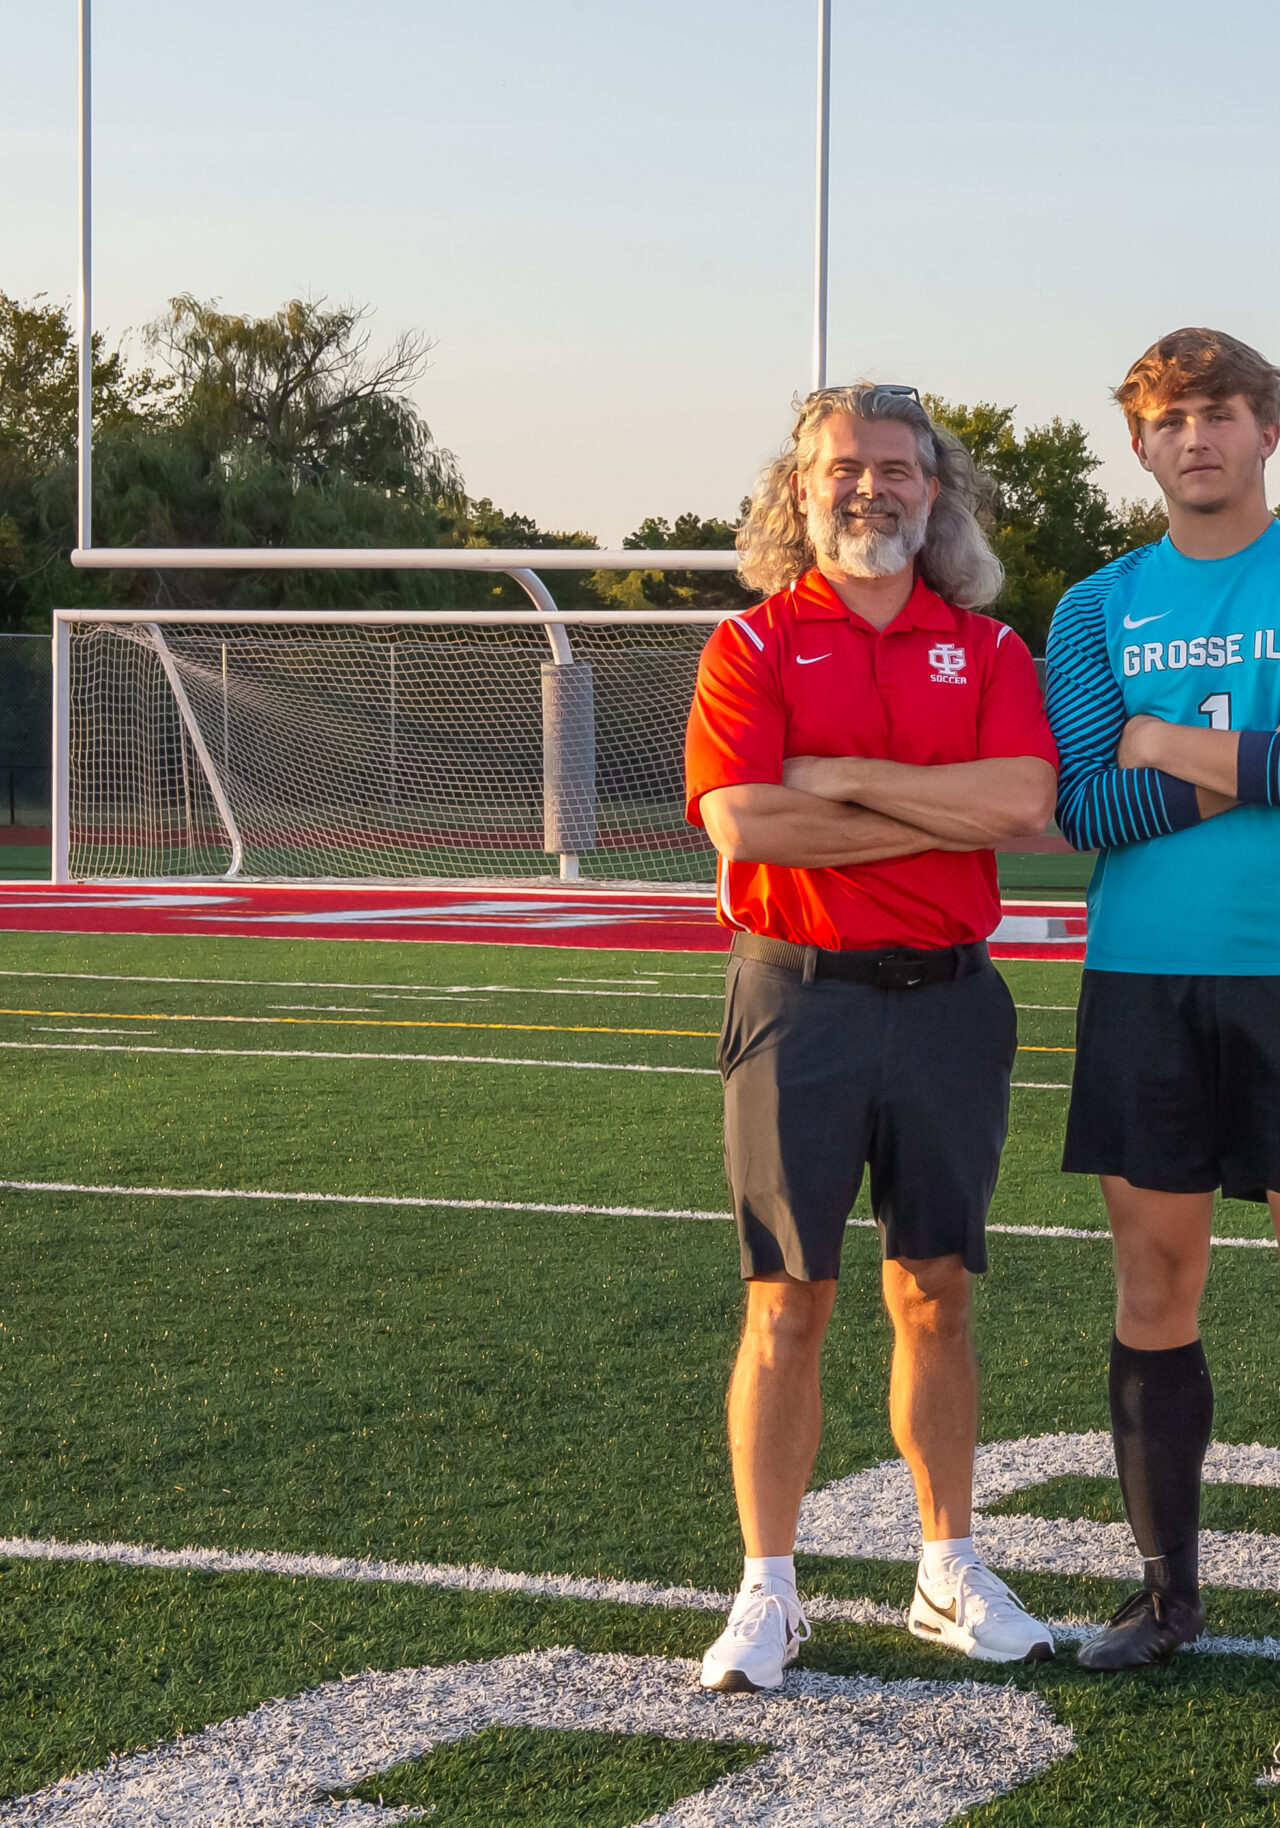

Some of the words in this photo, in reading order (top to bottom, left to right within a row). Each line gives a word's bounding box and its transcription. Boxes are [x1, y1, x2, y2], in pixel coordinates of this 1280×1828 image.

[1123, 633, 1244, 677] GROSSE
[930, 674, 967, 684] SOCCER
[1198, 691, 1232, 731] 1
